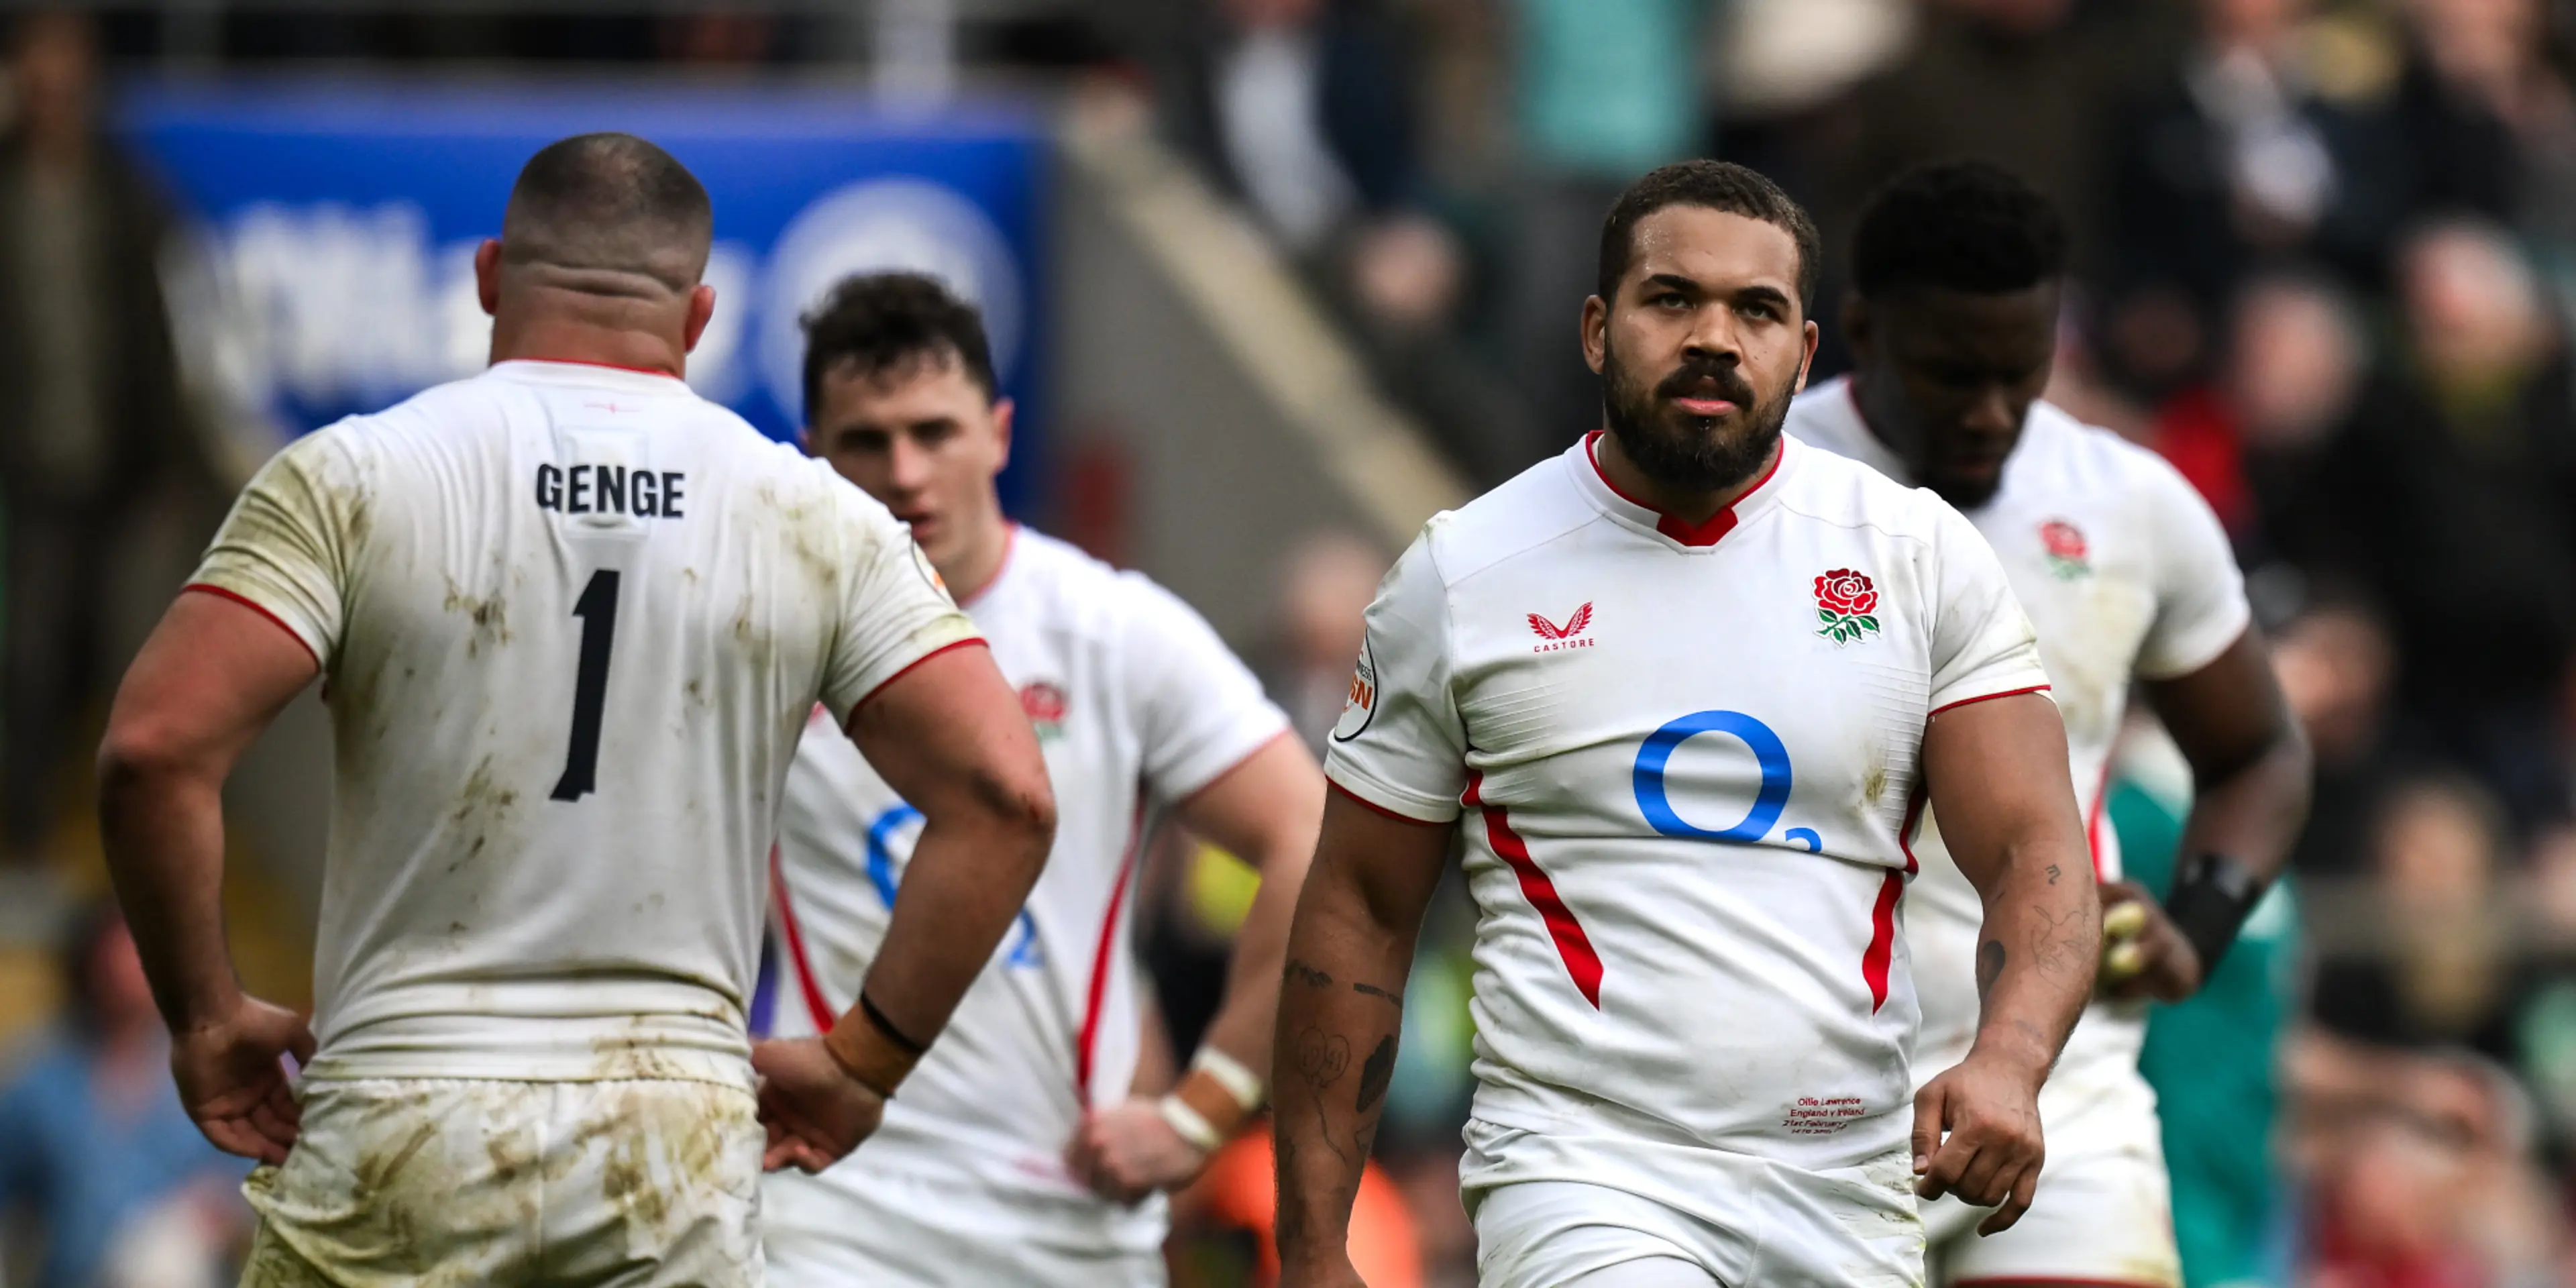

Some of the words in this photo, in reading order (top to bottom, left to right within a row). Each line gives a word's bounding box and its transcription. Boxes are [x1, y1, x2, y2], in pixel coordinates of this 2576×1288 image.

[537, 463, 686, 519] GENGE
[1534, 639, 1595, 653] CASTORE
[549, 568, 621, 802] 1
[1821, 1097, 1861, 1106] Lawrence
[1790, 1109, 1828, 1118] England
[1837, 1108, 1865, 1116] Ireland
